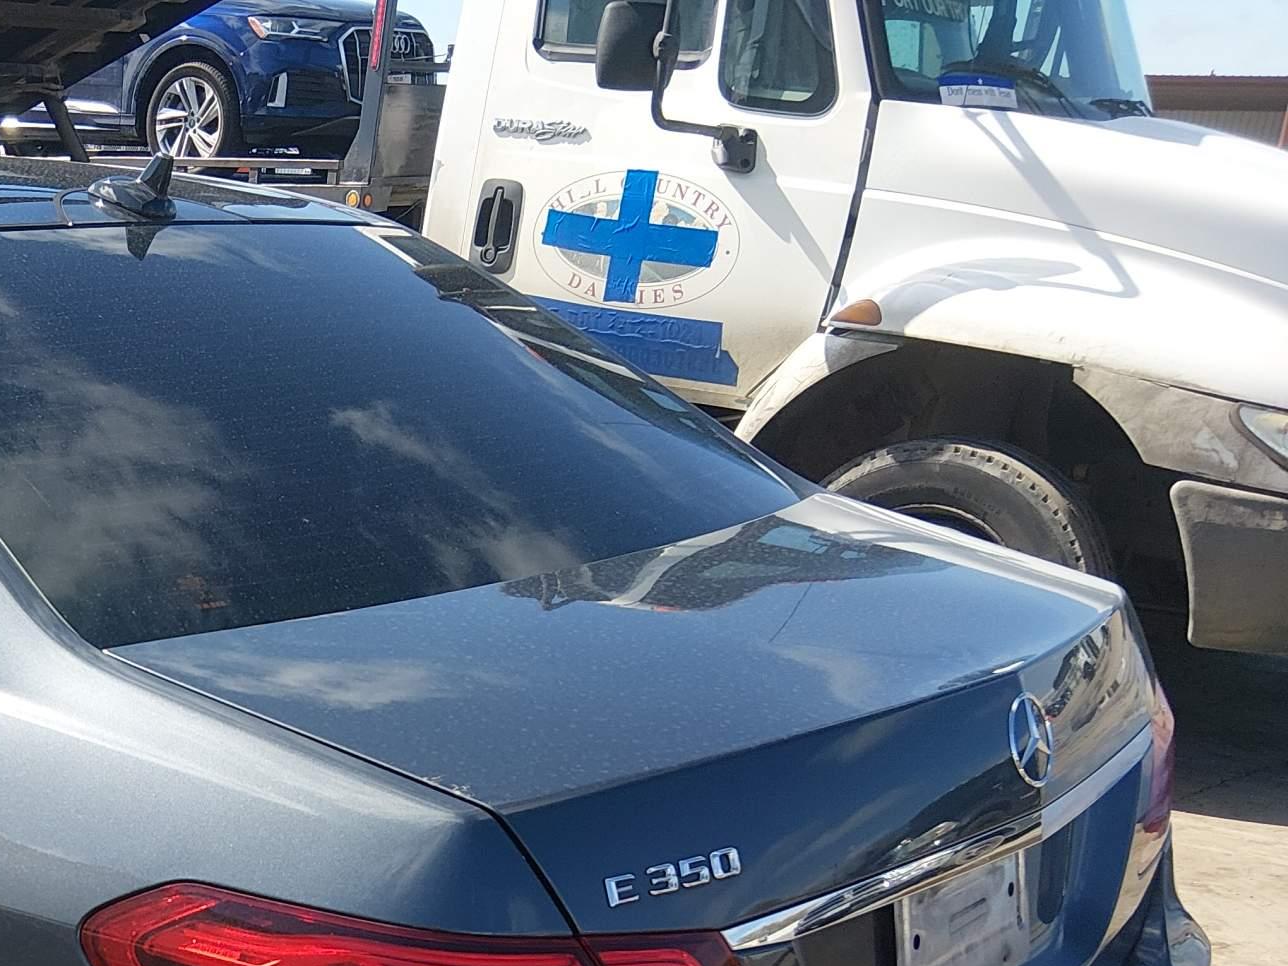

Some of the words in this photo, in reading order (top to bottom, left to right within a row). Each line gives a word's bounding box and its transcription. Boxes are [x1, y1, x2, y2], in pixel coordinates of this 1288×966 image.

[620, 176, 732, 229] UNTRY
[567, 273, 684, 305] DAIES
[605, 873, 640, 907] E
[646, 847, 741, 895] 350
